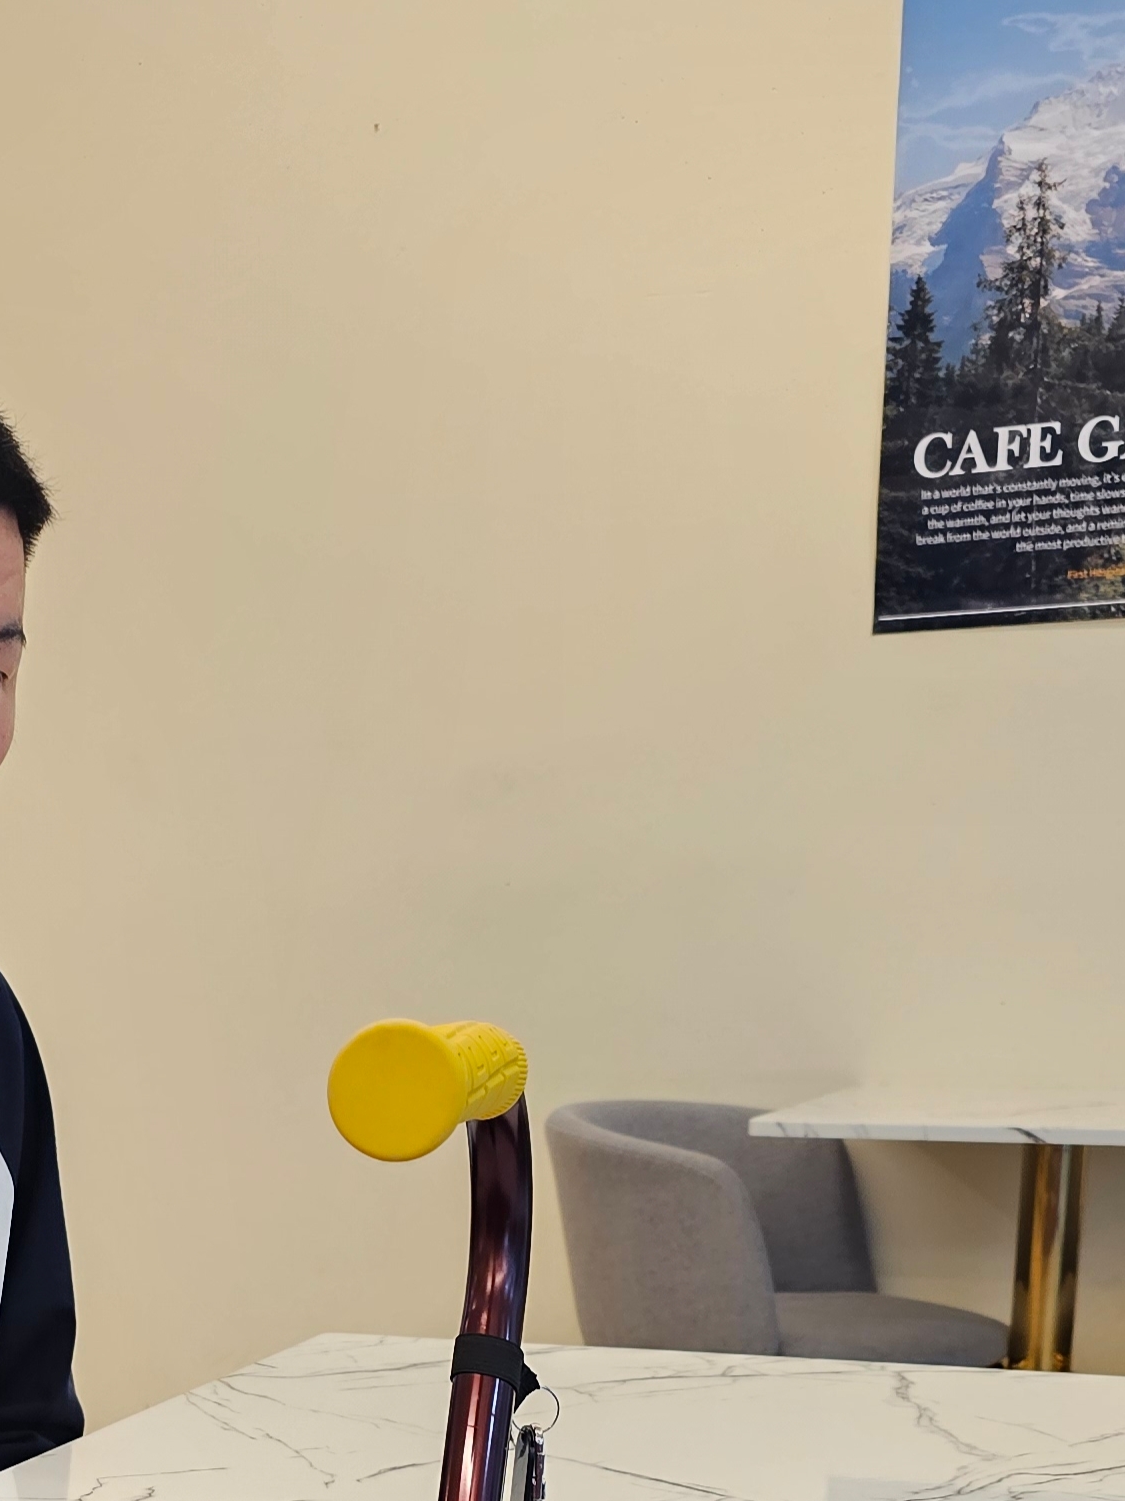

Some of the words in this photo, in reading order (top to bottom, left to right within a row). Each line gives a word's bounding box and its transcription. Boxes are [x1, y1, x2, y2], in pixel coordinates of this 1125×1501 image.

[913, 421, 1064, 479] CAFE
[1077, 414, 1125, 463] G
[921, 489, 932, 500] In
[933, 489, 940, 499] a
[941, 484, 971, 498] world
[972, 482, 1002, 496] that's
[1003, 477, 1058, 493] constantly
[922, 505, 929, 515] a
[930, 503, 949, 516] cup
[951, 500, 963, 512] of
[963, 498, 995, 512] coffee
[995, 497, 1007, 508] in
[1007, 498, 1032, 510] your
[1033, 492, 1069, 505] hands,
[1070, 490, 1095, 502] time
[927, 518, 945, 529] the
[946, 513, 989, 528] warmth,
[990, 511, 1010, 524] and
[1012, 509, 1026, 522] let
[1027, 510, 1051, 524] your
[1053, 505, 1101, 519] thoughts
[916, 532, 946, 546] break
[947, 531, 971, 543] from
[973, 529, 990, 540] the
[991, 525, 1021, 539] world
[1023, 522, 1065, 536] outside,
[1066, 520, 1087, 533] and
[1088, 522, 1096, 532] a
[1016, 541, 1034, 552] the
[1035, 539, 1062, 550] most
[1063, 534, 1121, 551] productive
